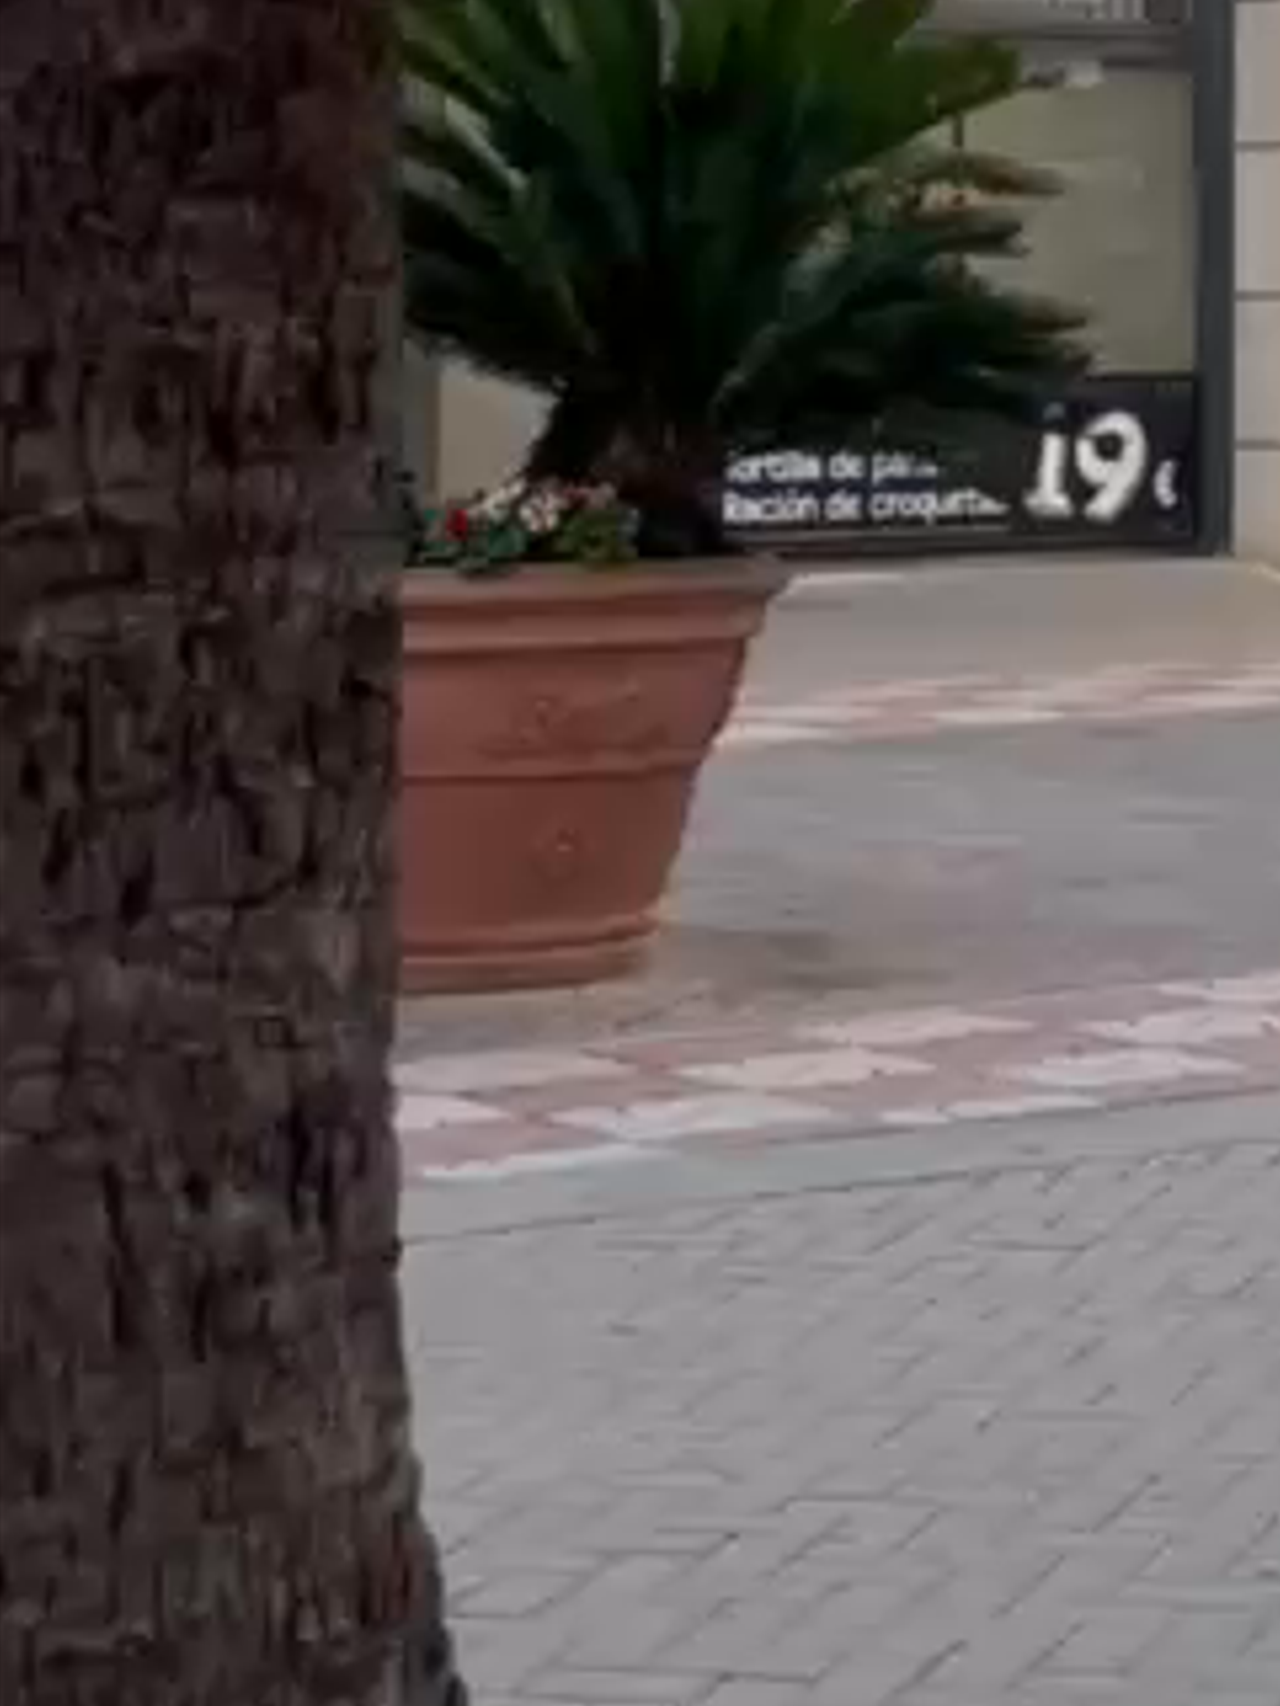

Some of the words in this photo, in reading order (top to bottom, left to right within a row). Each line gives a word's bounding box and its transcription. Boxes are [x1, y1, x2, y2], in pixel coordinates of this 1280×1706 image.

[828, 449, 865, 480] de
[721, 485, 821, 525] Ración
[824, 487, 863, 524] de
